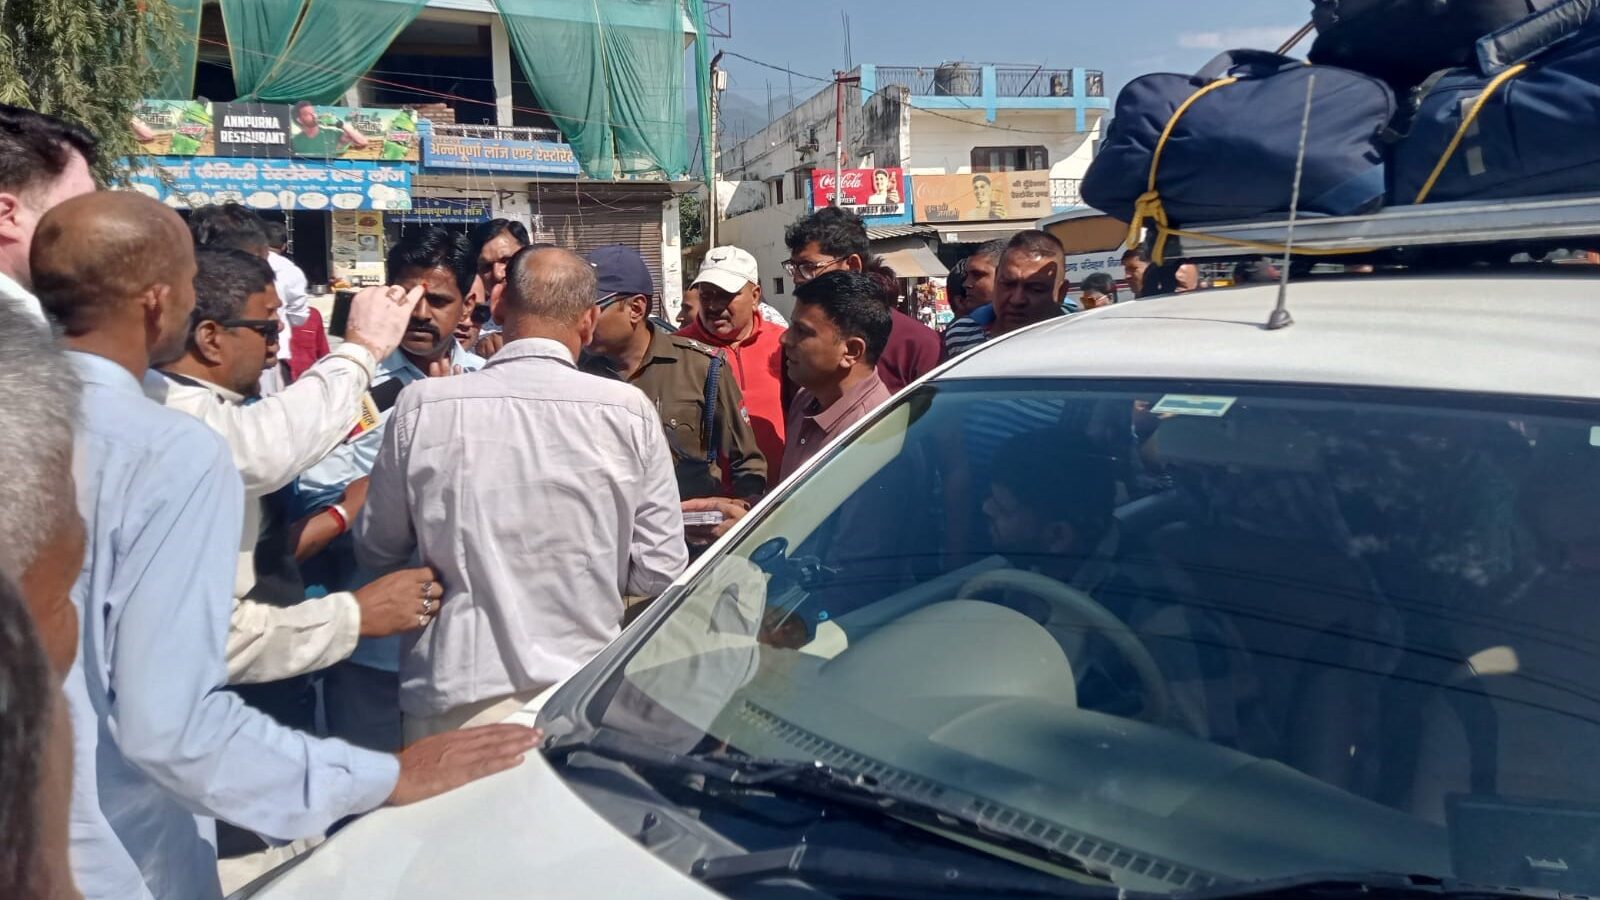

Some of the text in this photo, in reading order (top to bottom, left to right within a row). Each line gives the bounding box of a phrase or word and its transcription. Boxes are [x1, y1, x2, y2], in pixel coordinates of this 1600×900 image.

[223, 115, 280, 129] ANNPURNA
[220, 130, 286, 144] RESTAURANT
[431, 143, 481, 161] अन्नपूर्णा
[484, 145, 509, 159] लॉज
[366, 166, 405, 183] लॉज
